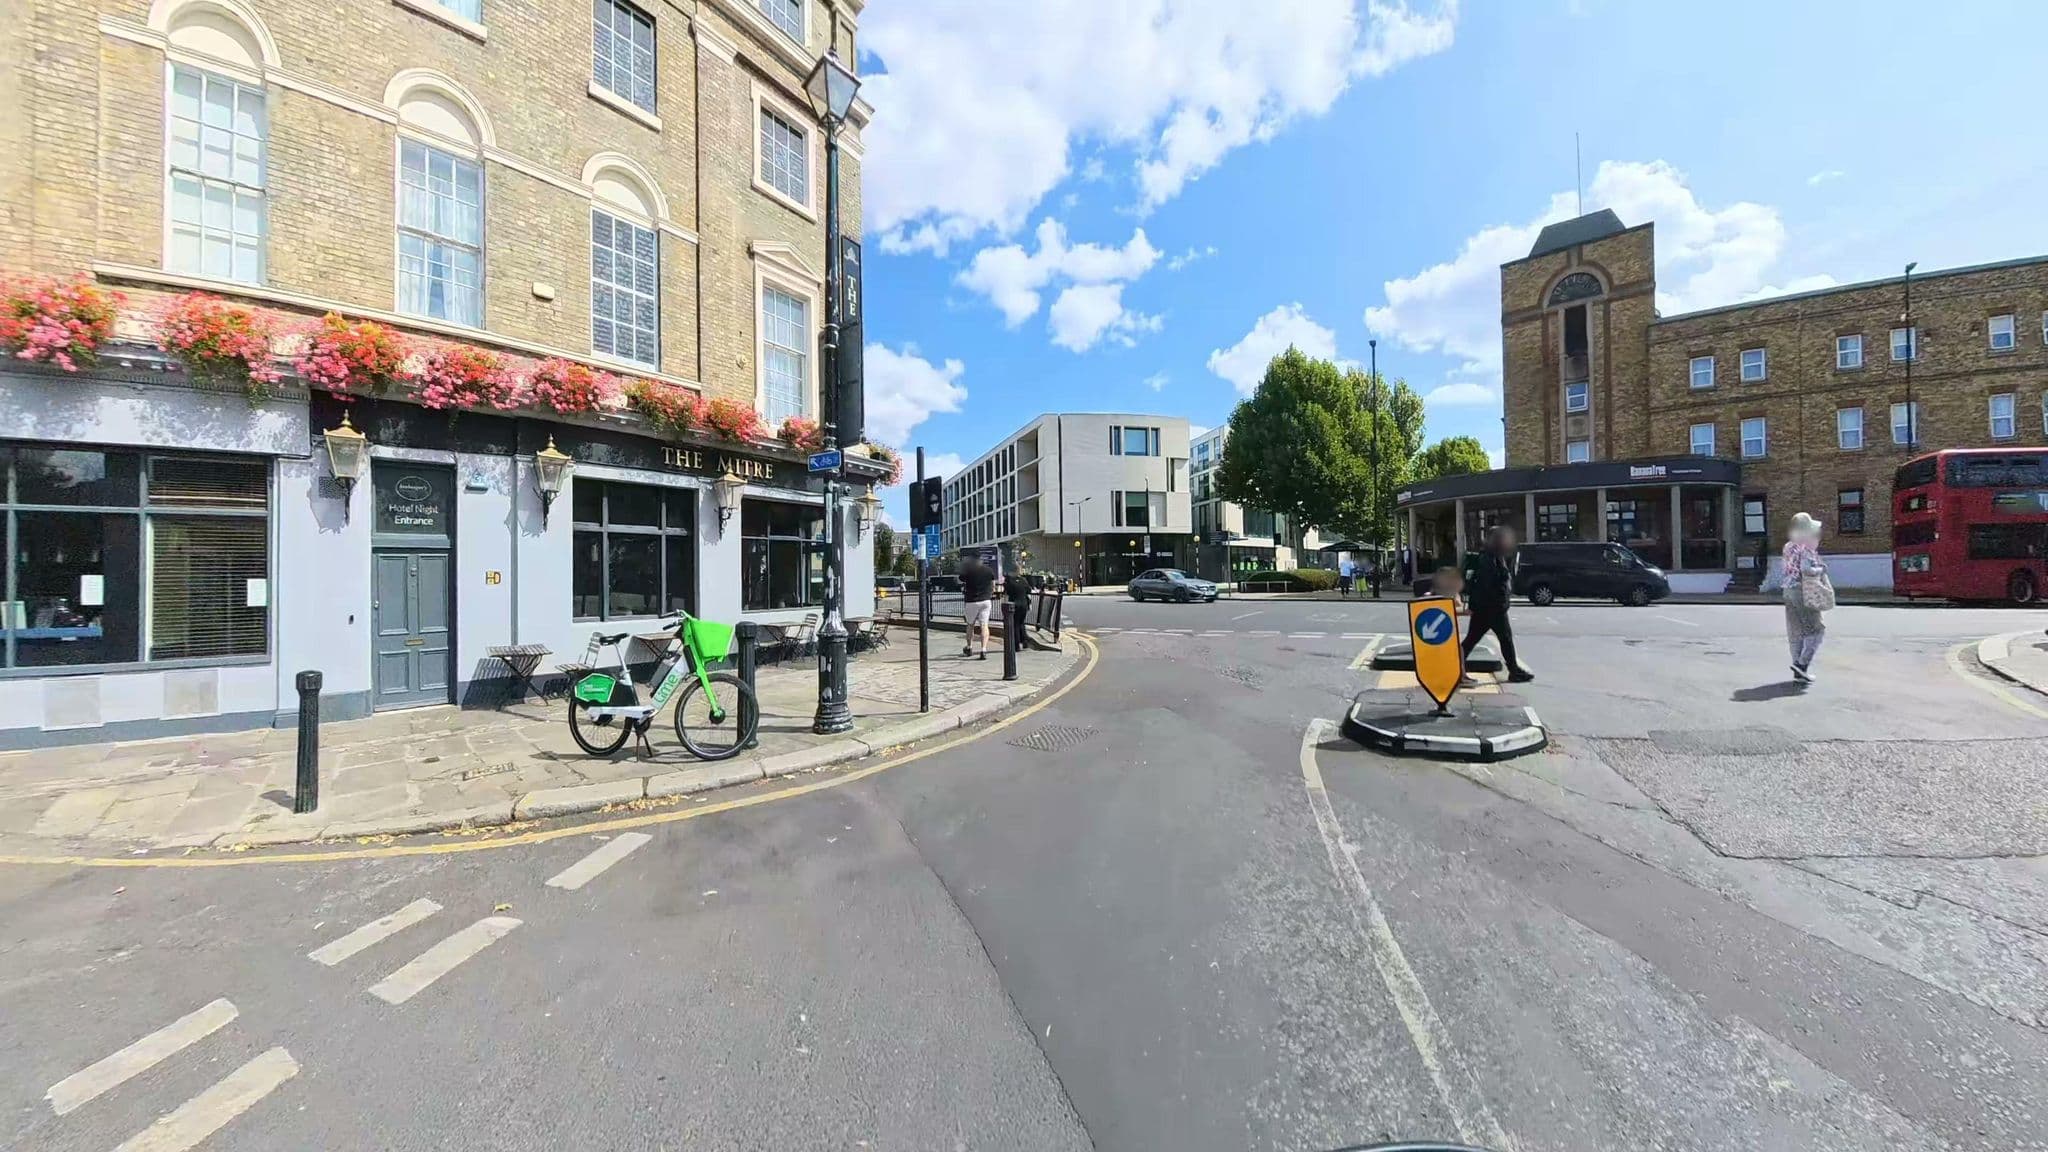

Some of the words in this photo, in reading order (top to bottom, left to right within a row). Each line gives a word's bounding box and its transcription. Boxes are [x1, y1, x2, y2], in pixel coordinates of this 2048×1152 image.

[847, 275, 857, 316] THE
[661, 447, 703, 469] THE
[717, 455, 774, 479] MITRE
[388, 503, 414, 513] Hotel
[415, 504, 439, 515] Night
[394, 515, 434, 526] Entrance
